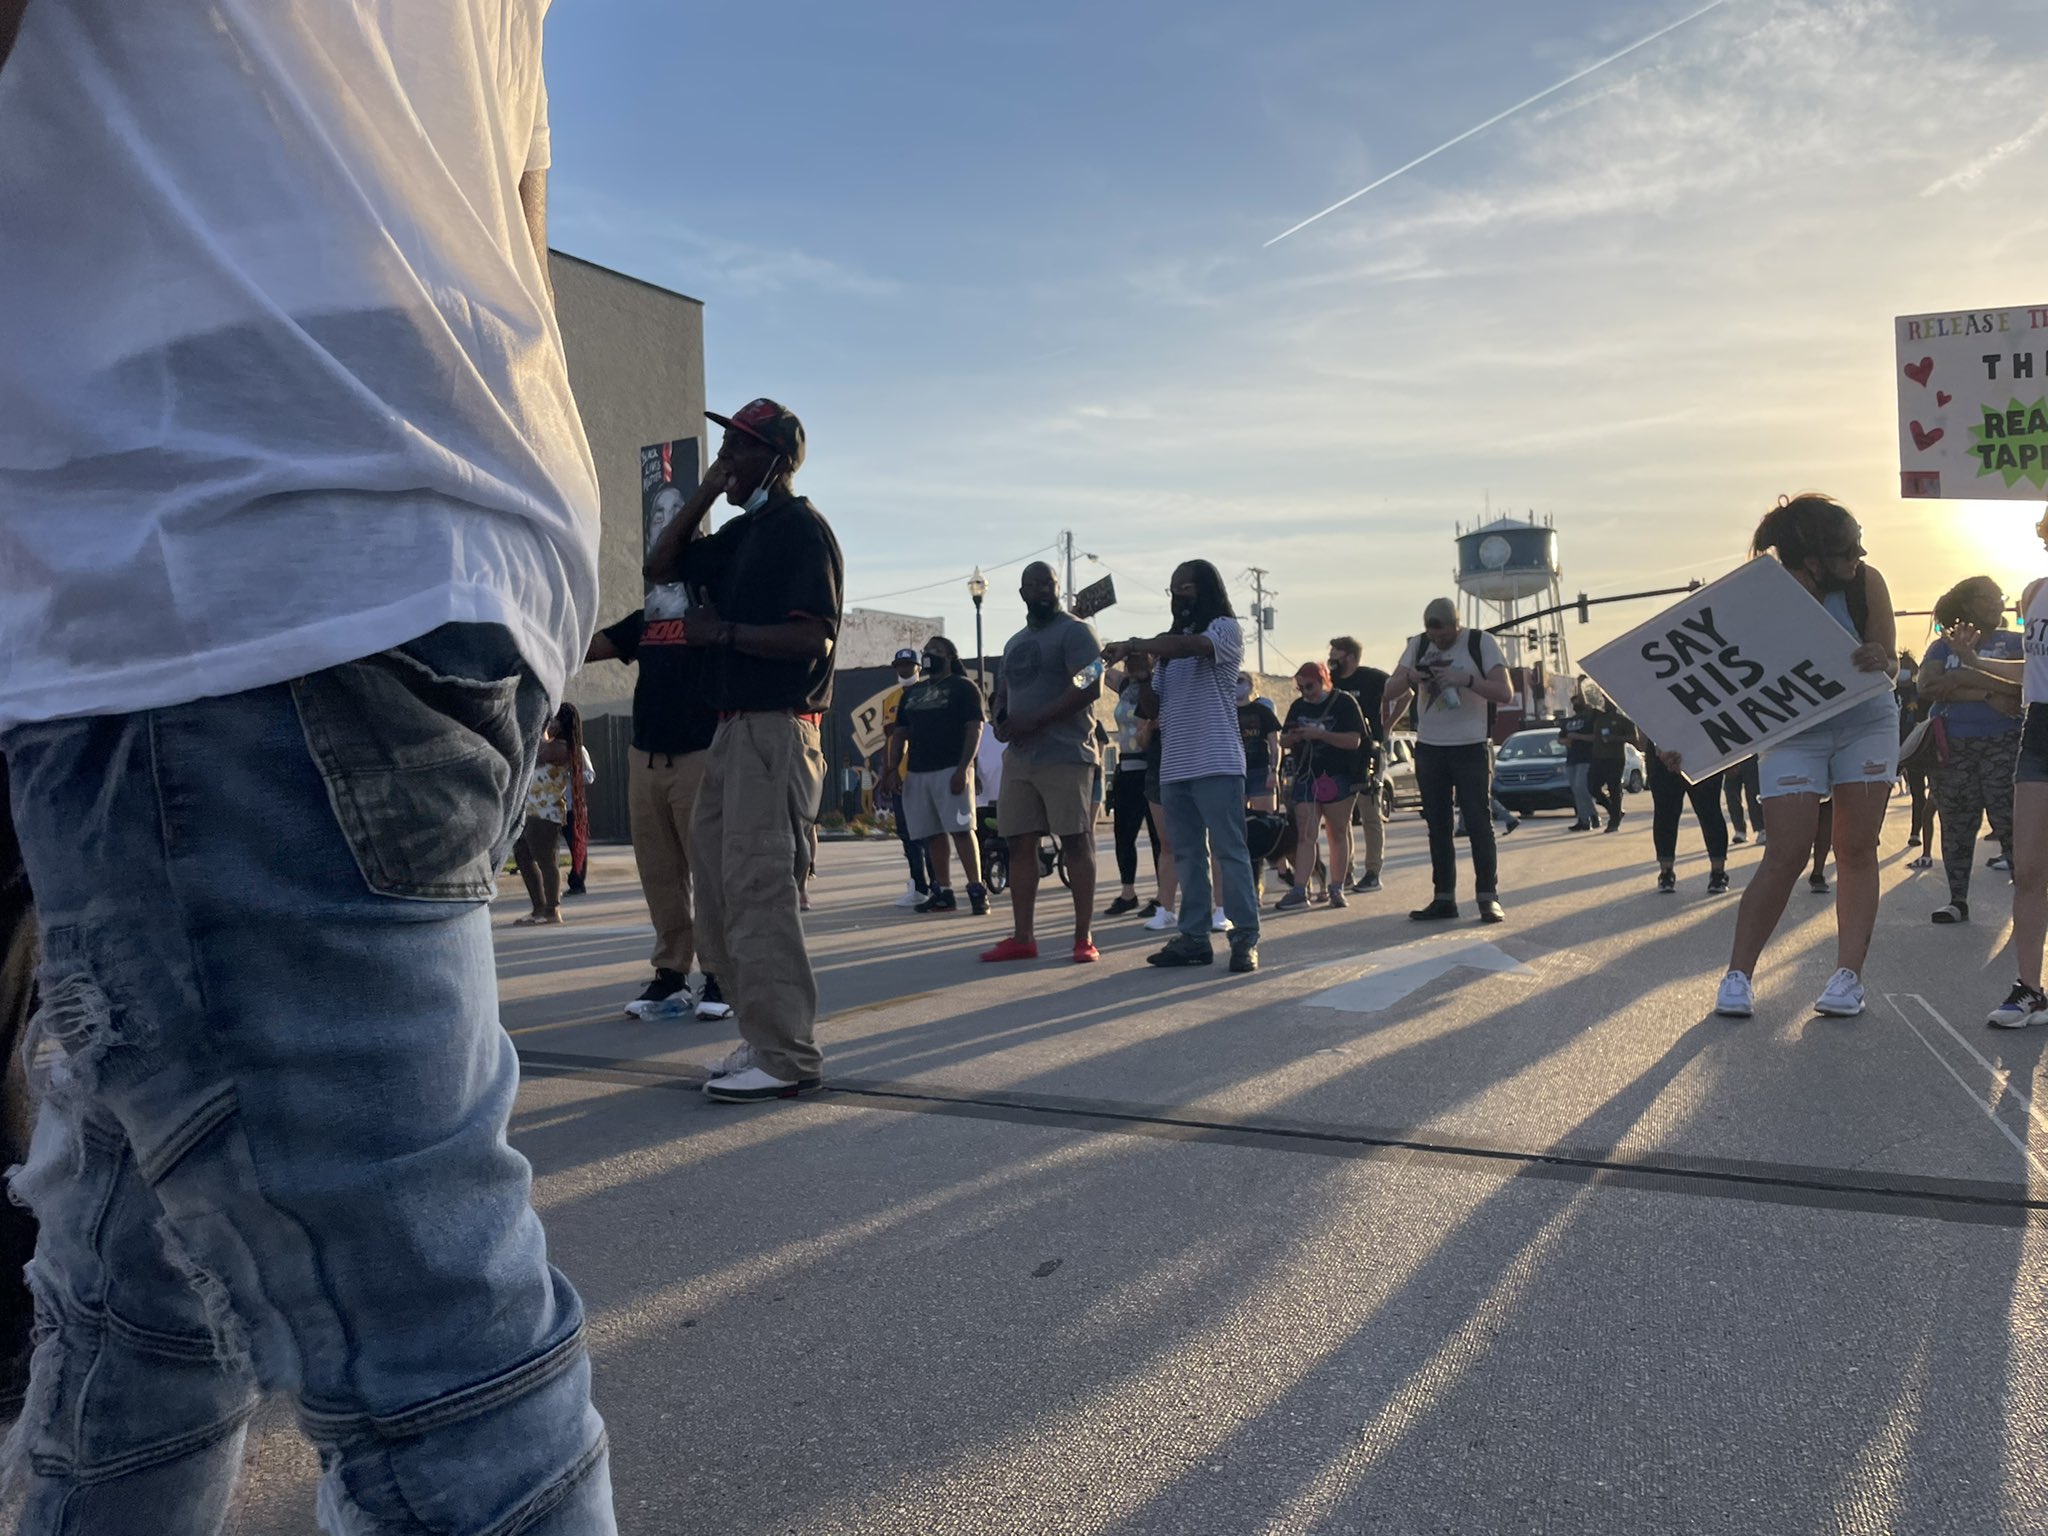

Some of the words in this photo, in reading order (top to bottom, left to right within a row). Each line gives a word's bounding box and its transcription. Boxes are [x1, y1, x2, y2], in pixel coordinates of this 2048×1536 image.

[1908, 313, 2010, 340] RELEASE
[1641, 606, 1728, 679] SAY
[1667, 646, 1764, 715] HIS
[1700, 659, 1846, 755] NAME
